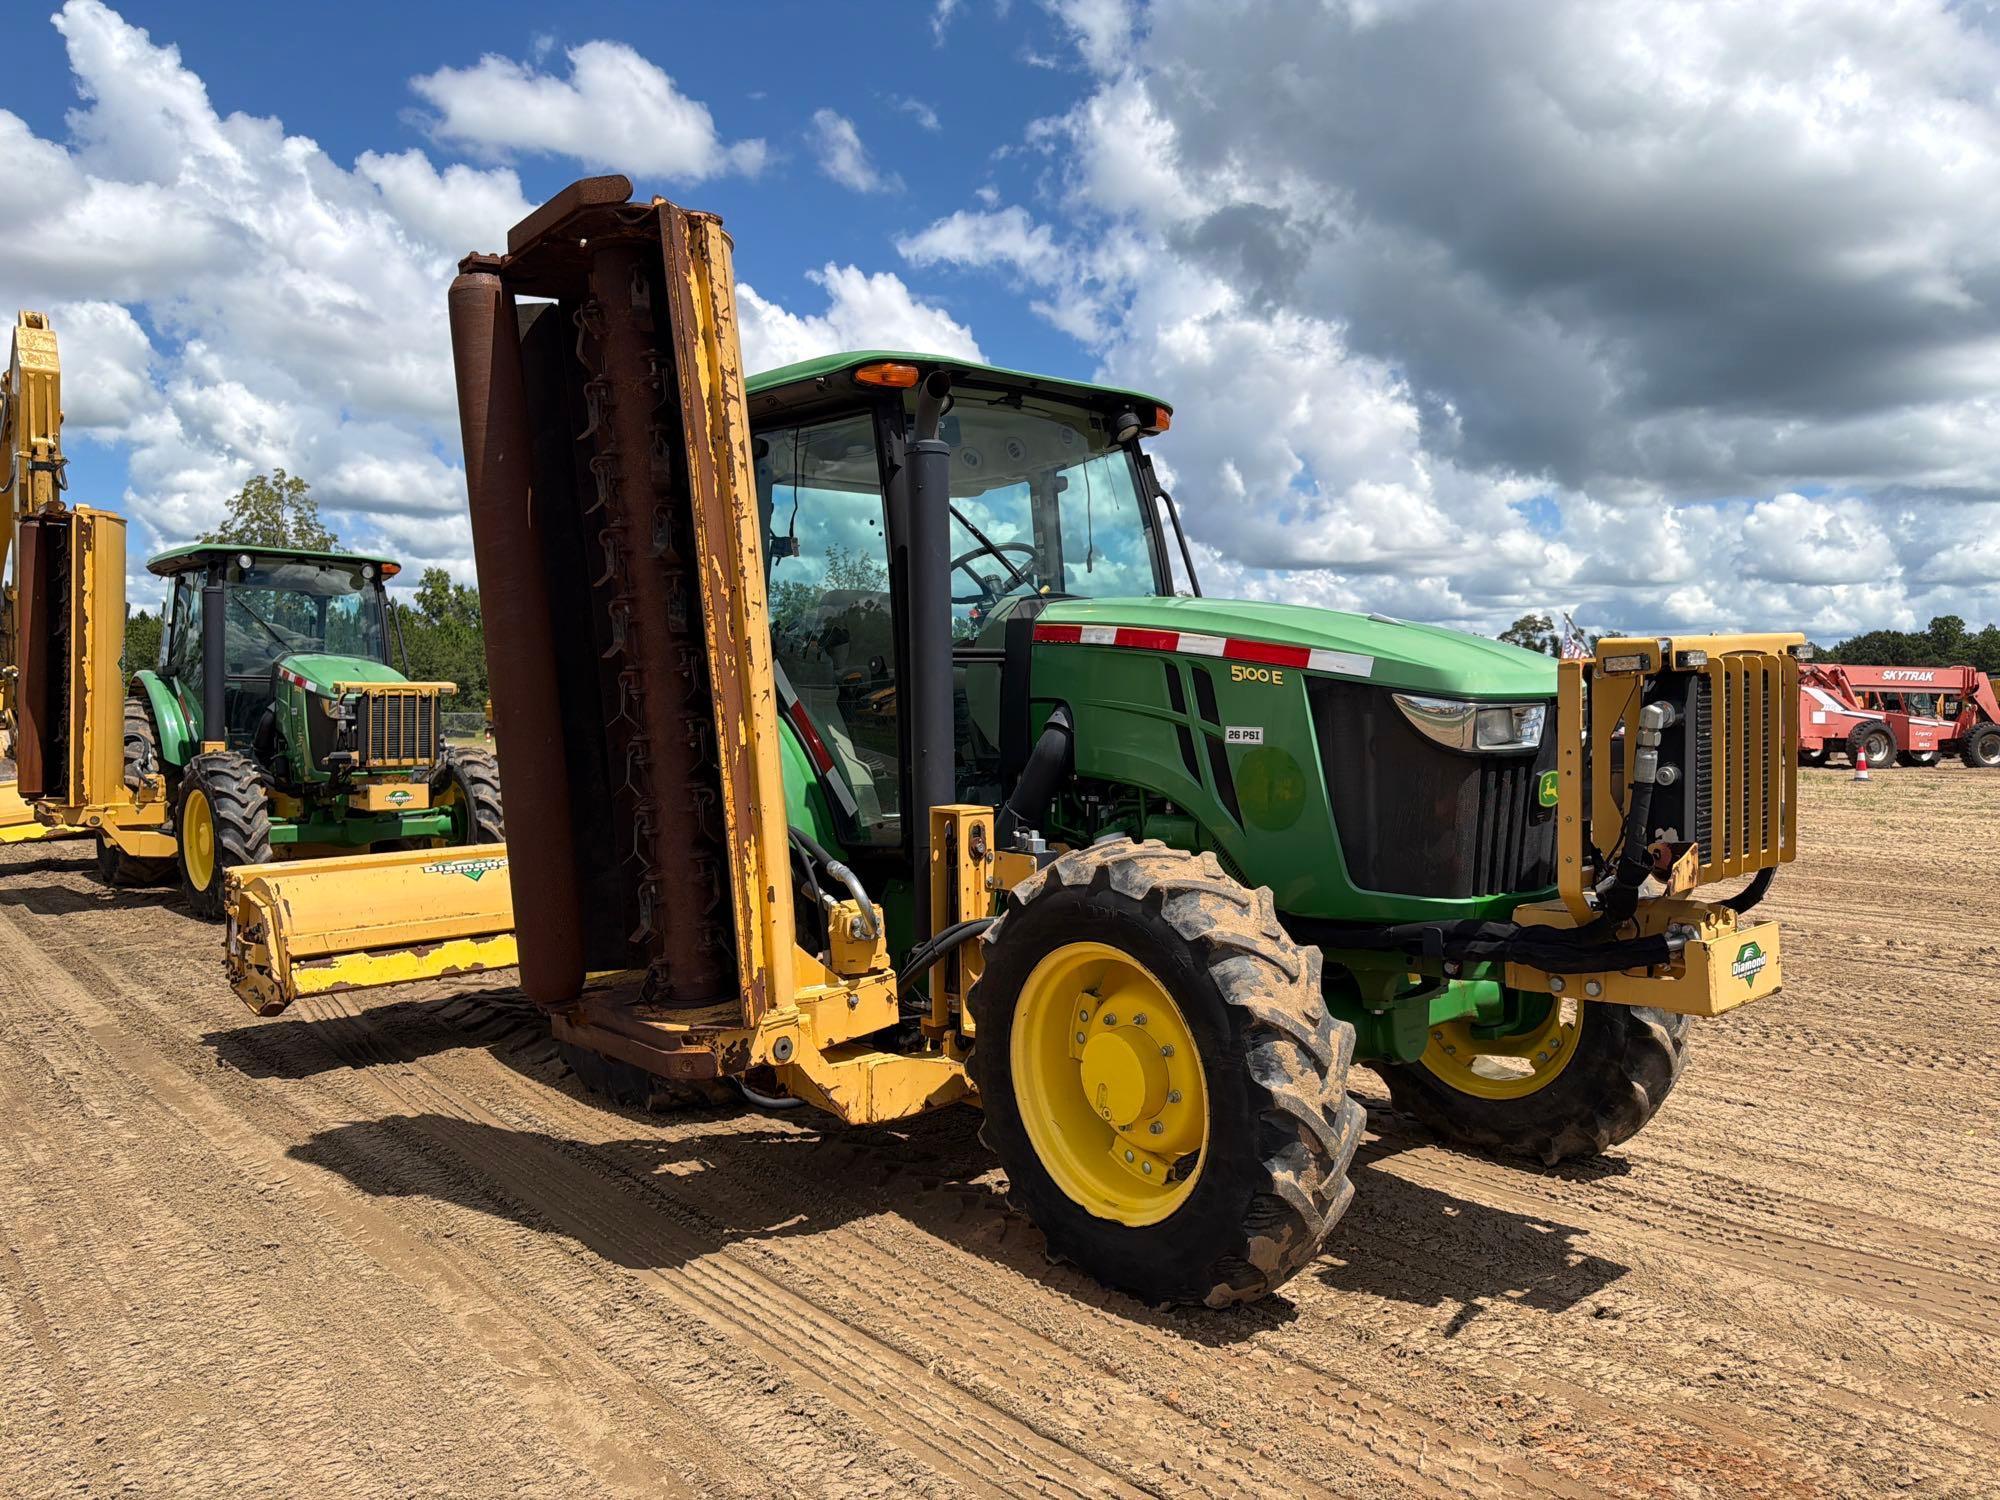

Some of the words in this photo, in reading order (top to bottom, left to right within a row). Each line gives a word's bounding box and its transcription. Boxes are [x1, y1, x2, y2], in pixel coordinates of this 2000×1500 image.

[1882, 670, 1934, 682] SKYTRAK
[1945, 701, 1958, 710] CAT
[1228, 730, 1240, 740] 26
[1242, 730, 1260, 740] PSI
[1732, 953, 1766, 976] Diamond
